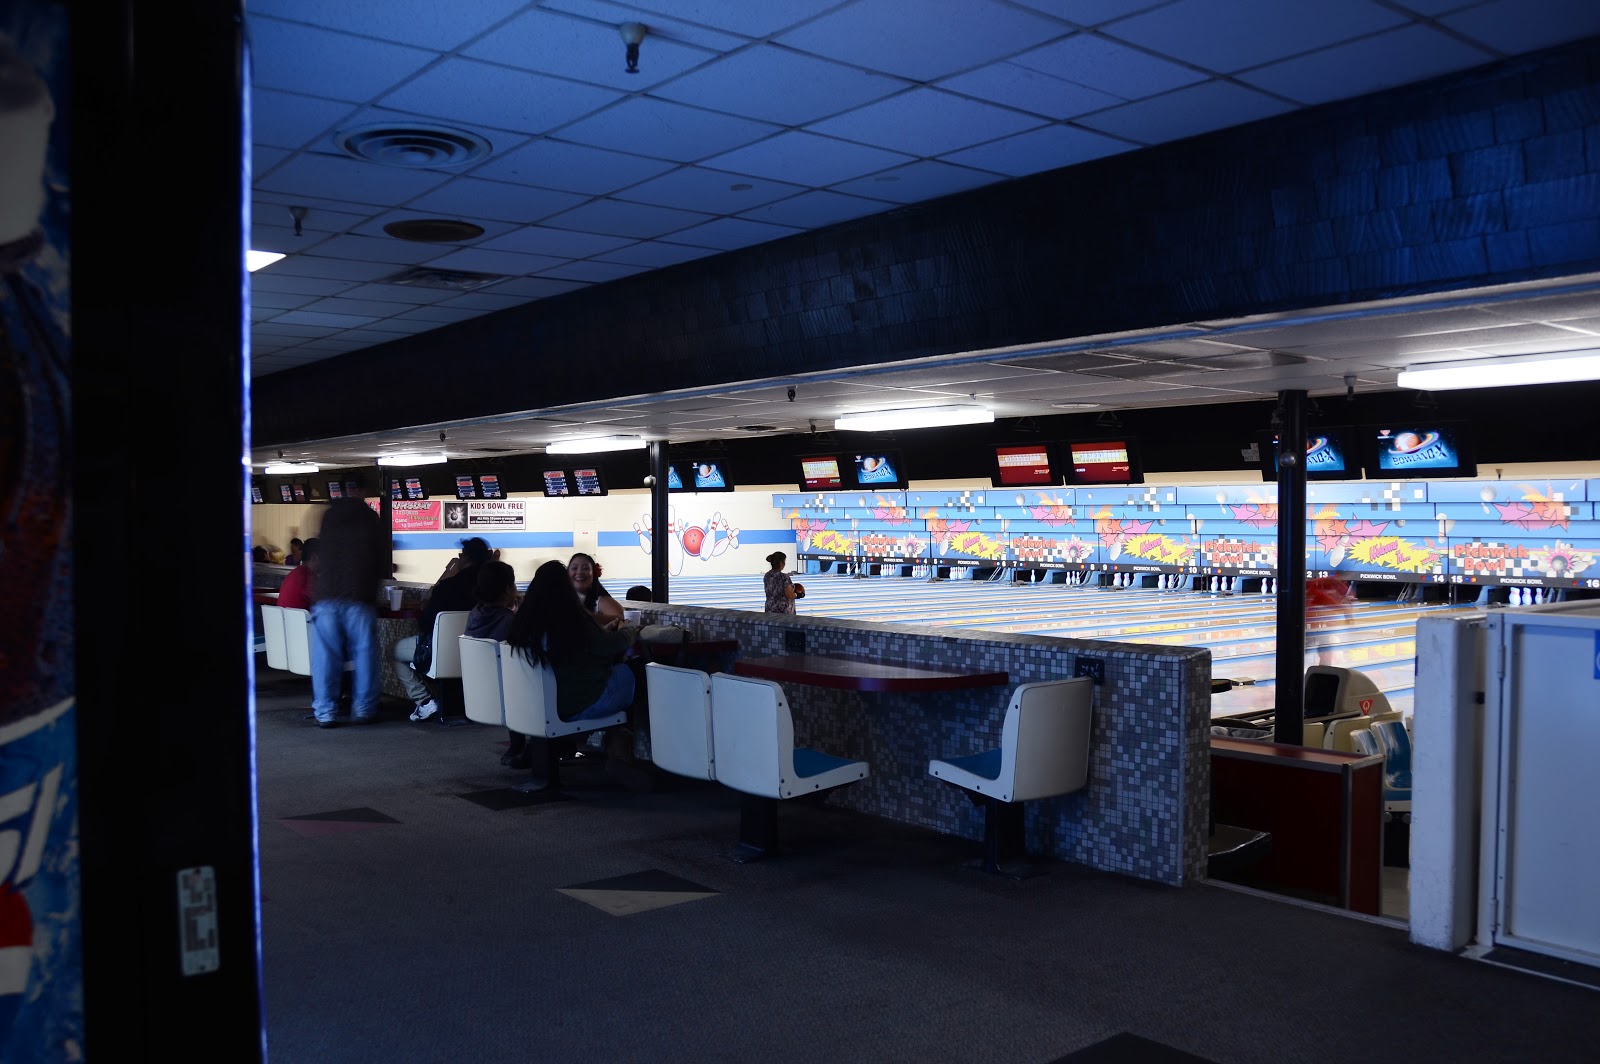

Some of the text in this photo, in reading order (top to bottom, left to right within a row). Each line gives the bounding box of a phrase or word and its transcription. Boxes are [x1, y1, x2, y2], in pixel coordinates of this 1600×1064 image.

[1307, 447, 1336, 465] AND-X
[1013, 538, 1057, 548] Pickwick
[1205, 540, 1260, 552] Pickwick
[1019, 548, 1044, 558] Bowl
[1370, 540, 1398, 561] Welcome
[1454, 544, 1529, 558] Pickwick
[1212, 552, 1244, 564] Bowl
[1464, 558, 1506, 571] Bowl
[1586, 579, 1600, 588] 16
